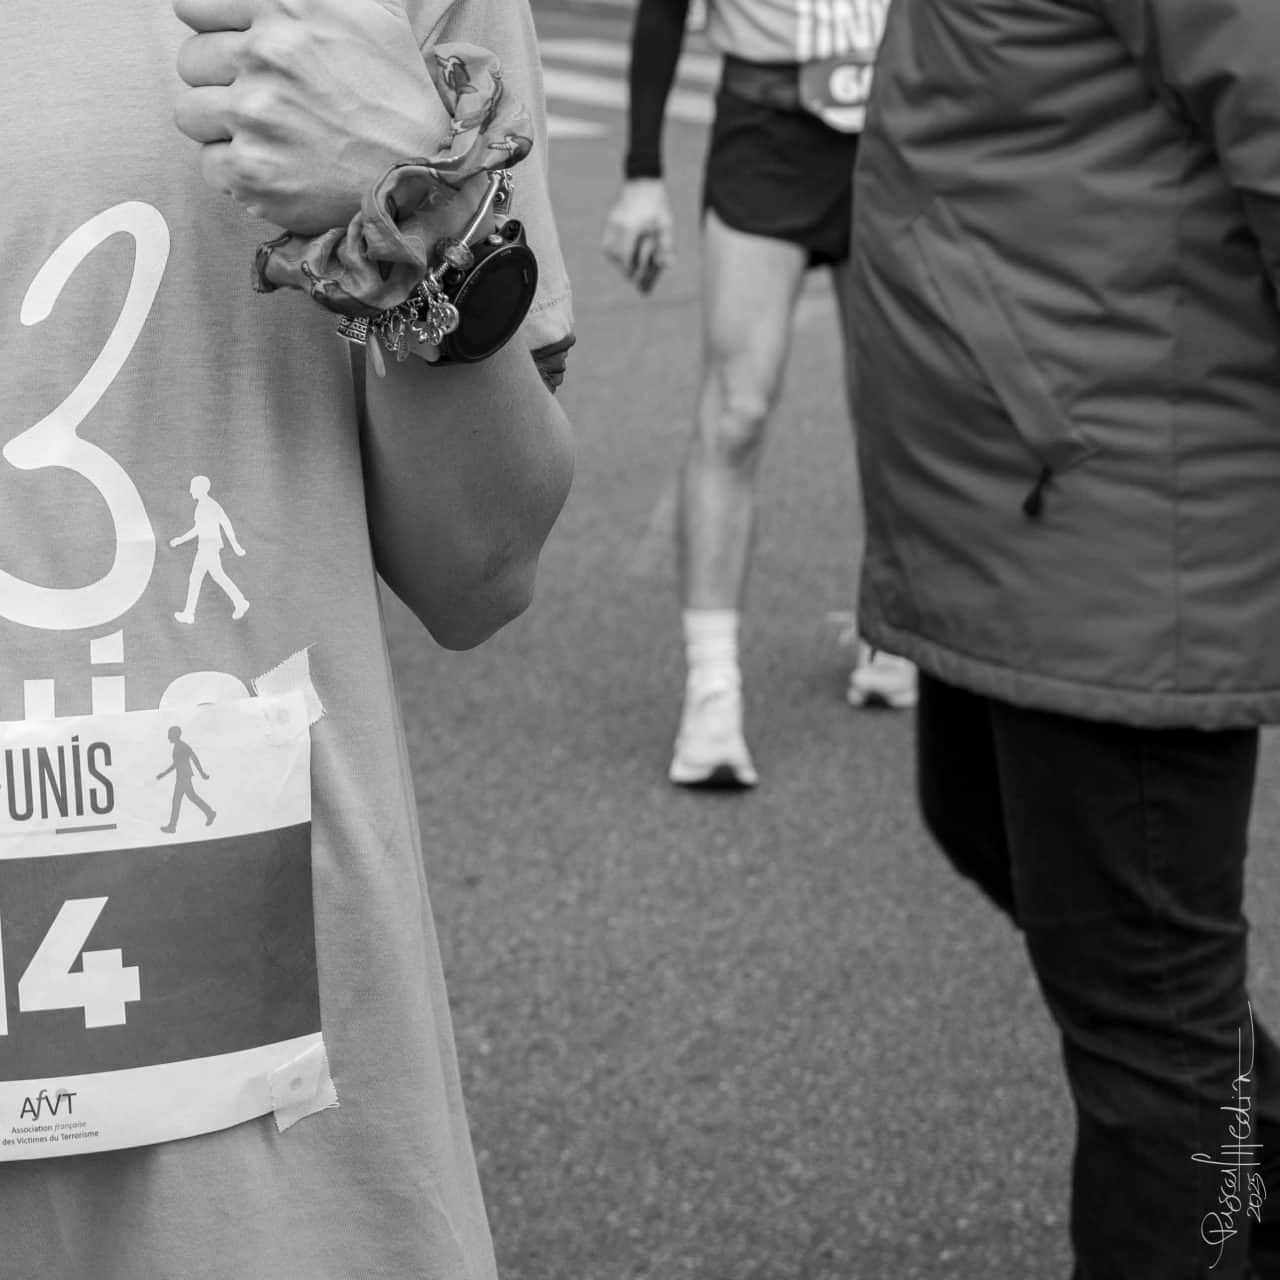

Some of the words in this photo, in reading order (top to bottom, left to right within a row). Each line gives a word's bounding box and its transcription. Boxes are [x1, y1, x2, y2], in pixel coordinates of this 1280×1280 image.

[11, 1124, 53, 1134] Association
[2, 1137, 15, 1146] des
[17, 1134, 48, 1145] Victimes
[49, 1134, 59, 1142] du
[60, 1130, 99, 1141] Terrorisme
